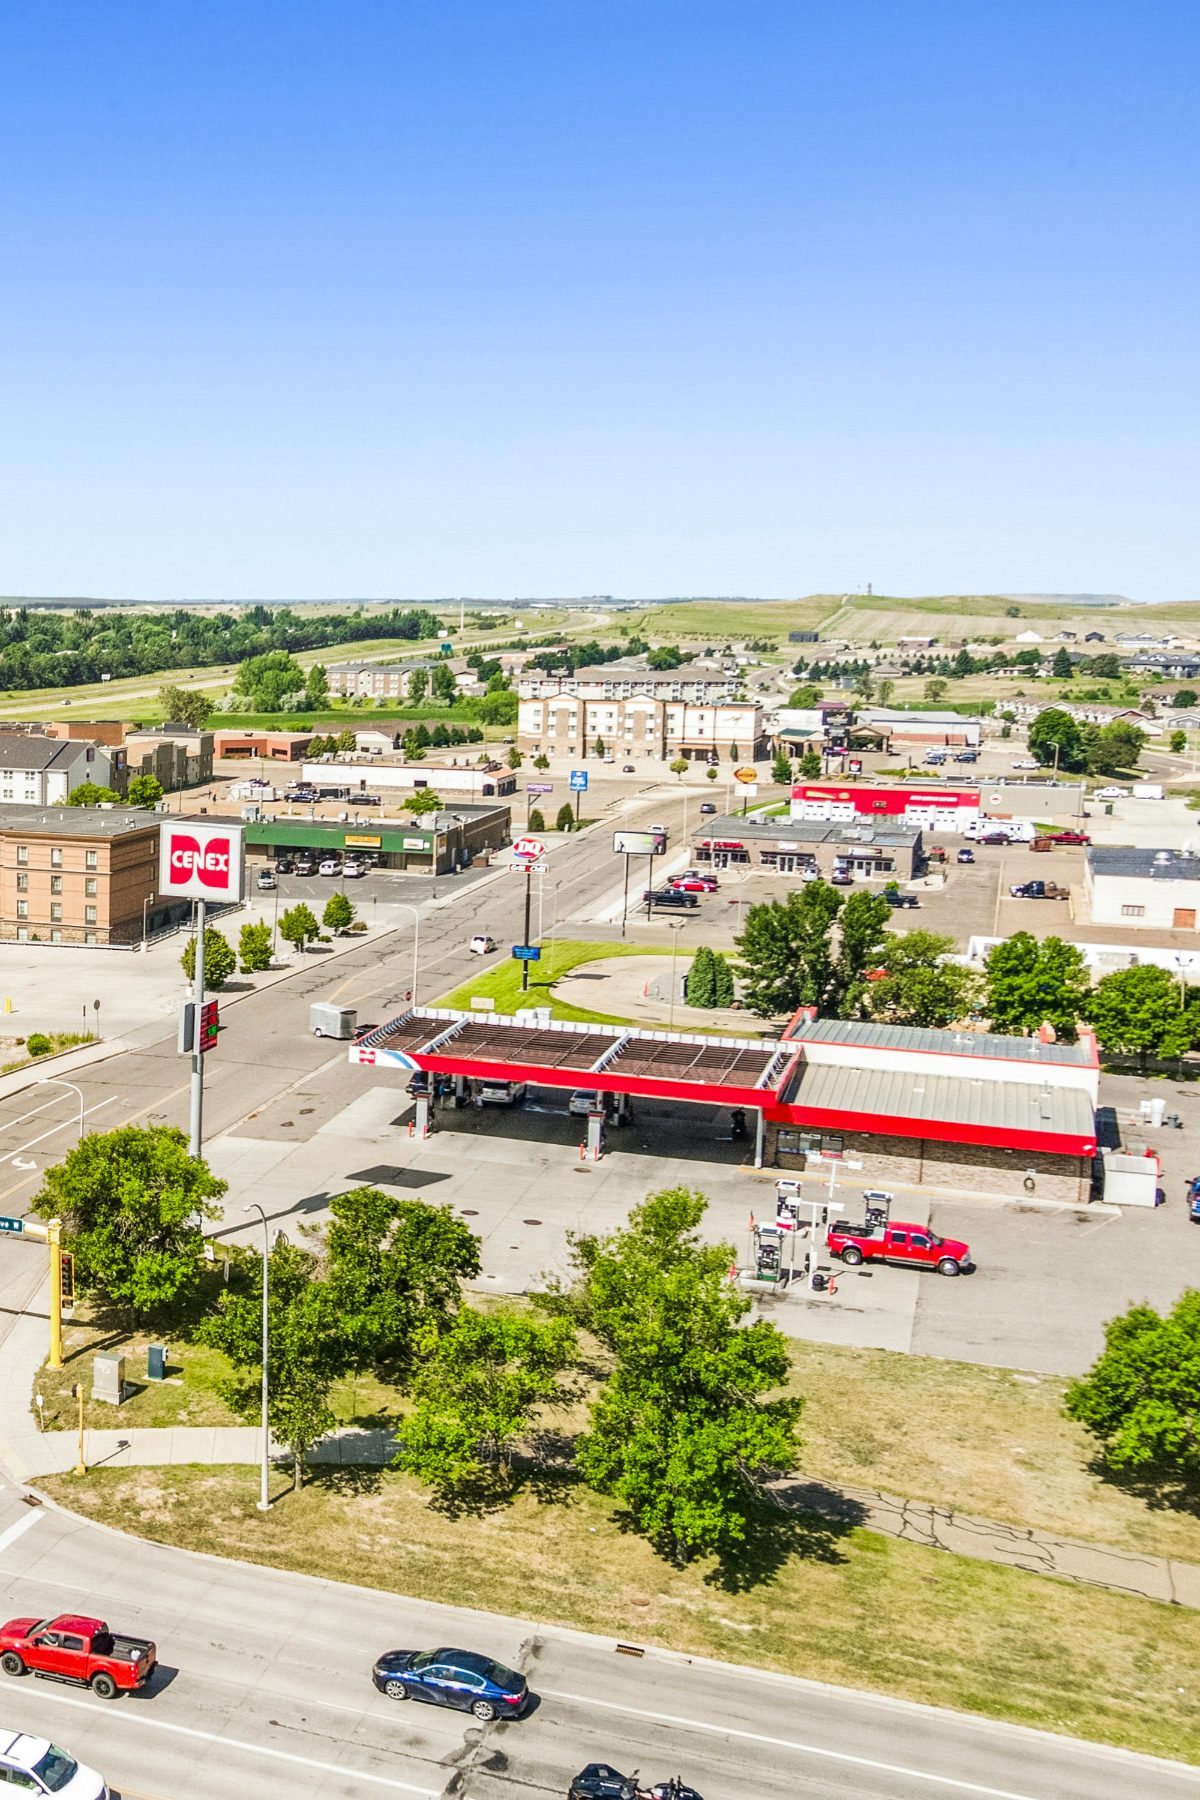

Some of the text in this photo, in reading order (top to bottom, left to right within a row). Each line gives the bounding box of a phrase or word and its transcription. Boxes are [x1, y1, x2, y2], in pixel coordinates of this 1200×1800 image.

[518, 841, 541, 854] DQ
[171, 849, 228, 871] CENEX
[13, 1221, 20, 1229] W
